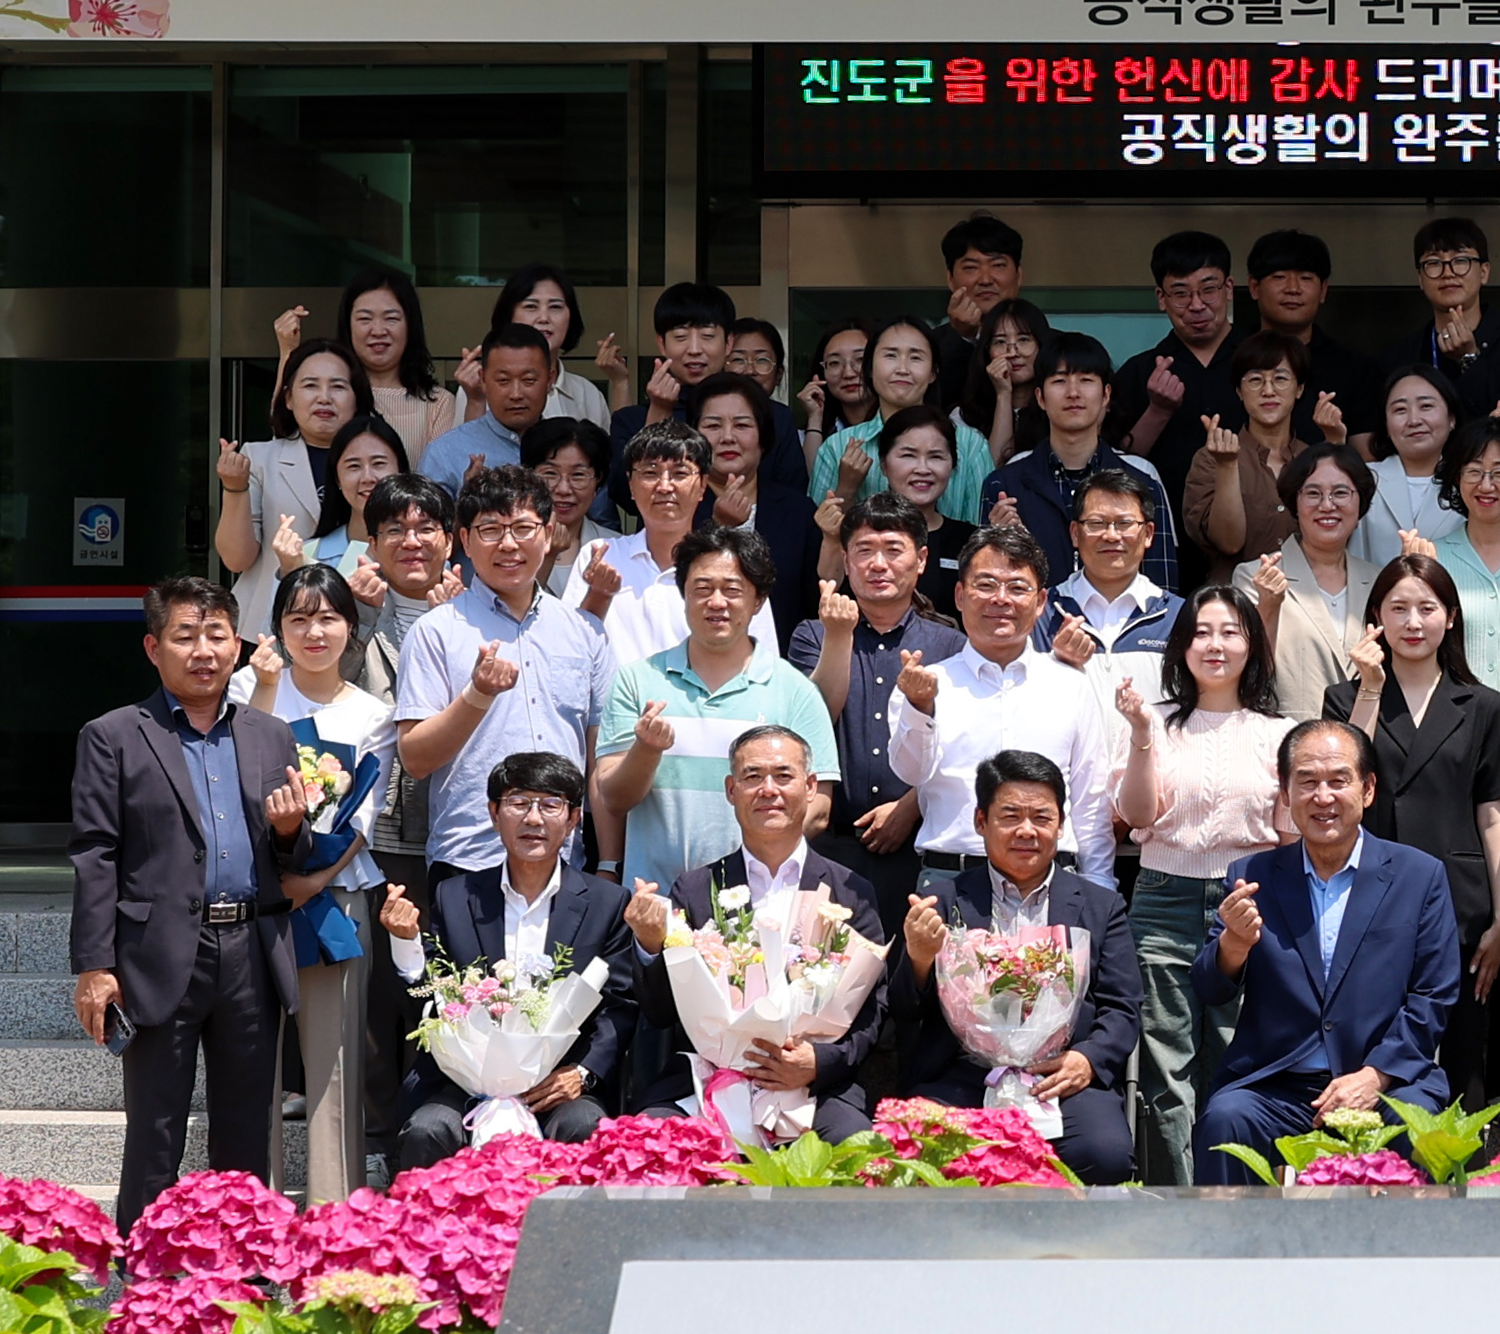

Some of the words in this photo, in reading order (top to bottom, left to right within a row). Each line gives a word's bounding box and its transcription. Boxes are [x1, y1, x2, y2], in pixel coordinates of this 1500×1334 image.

[1005, 57, 1097, 104] 위한
[1114, 57, 1250, 104] 헌신에
[1121, 113, 1369, 164] 공직생활의
[79, 549, 118, 560] 금연시설
